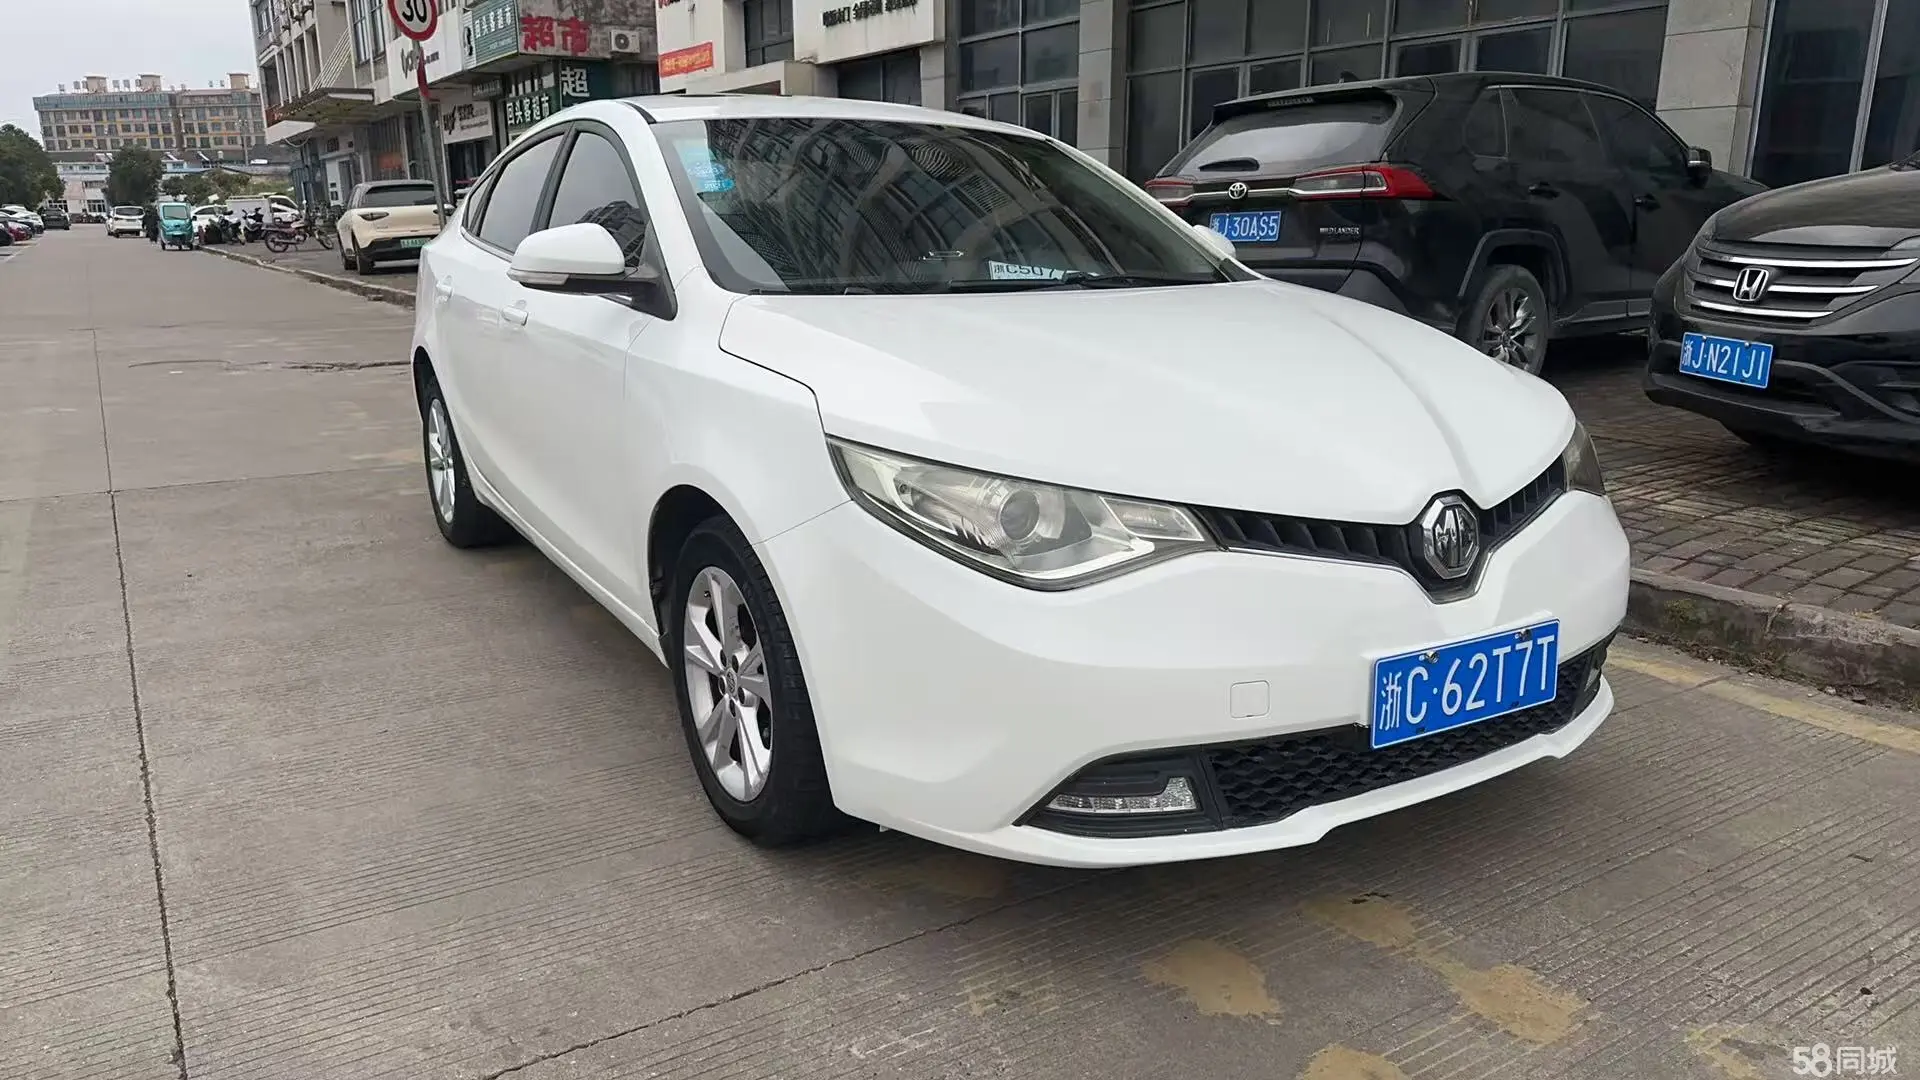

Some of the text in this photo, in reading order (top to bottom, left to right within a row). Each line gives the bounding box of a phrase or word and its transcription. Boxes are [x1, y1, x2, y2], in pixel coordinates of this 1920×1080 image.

[401, 0, 428, 24] 30
[521, 16, 591, 55] 超市
[506, 93, 550, 126] 回头客超市
[1379, 635, 1555, 731] 浙C·62T7T
